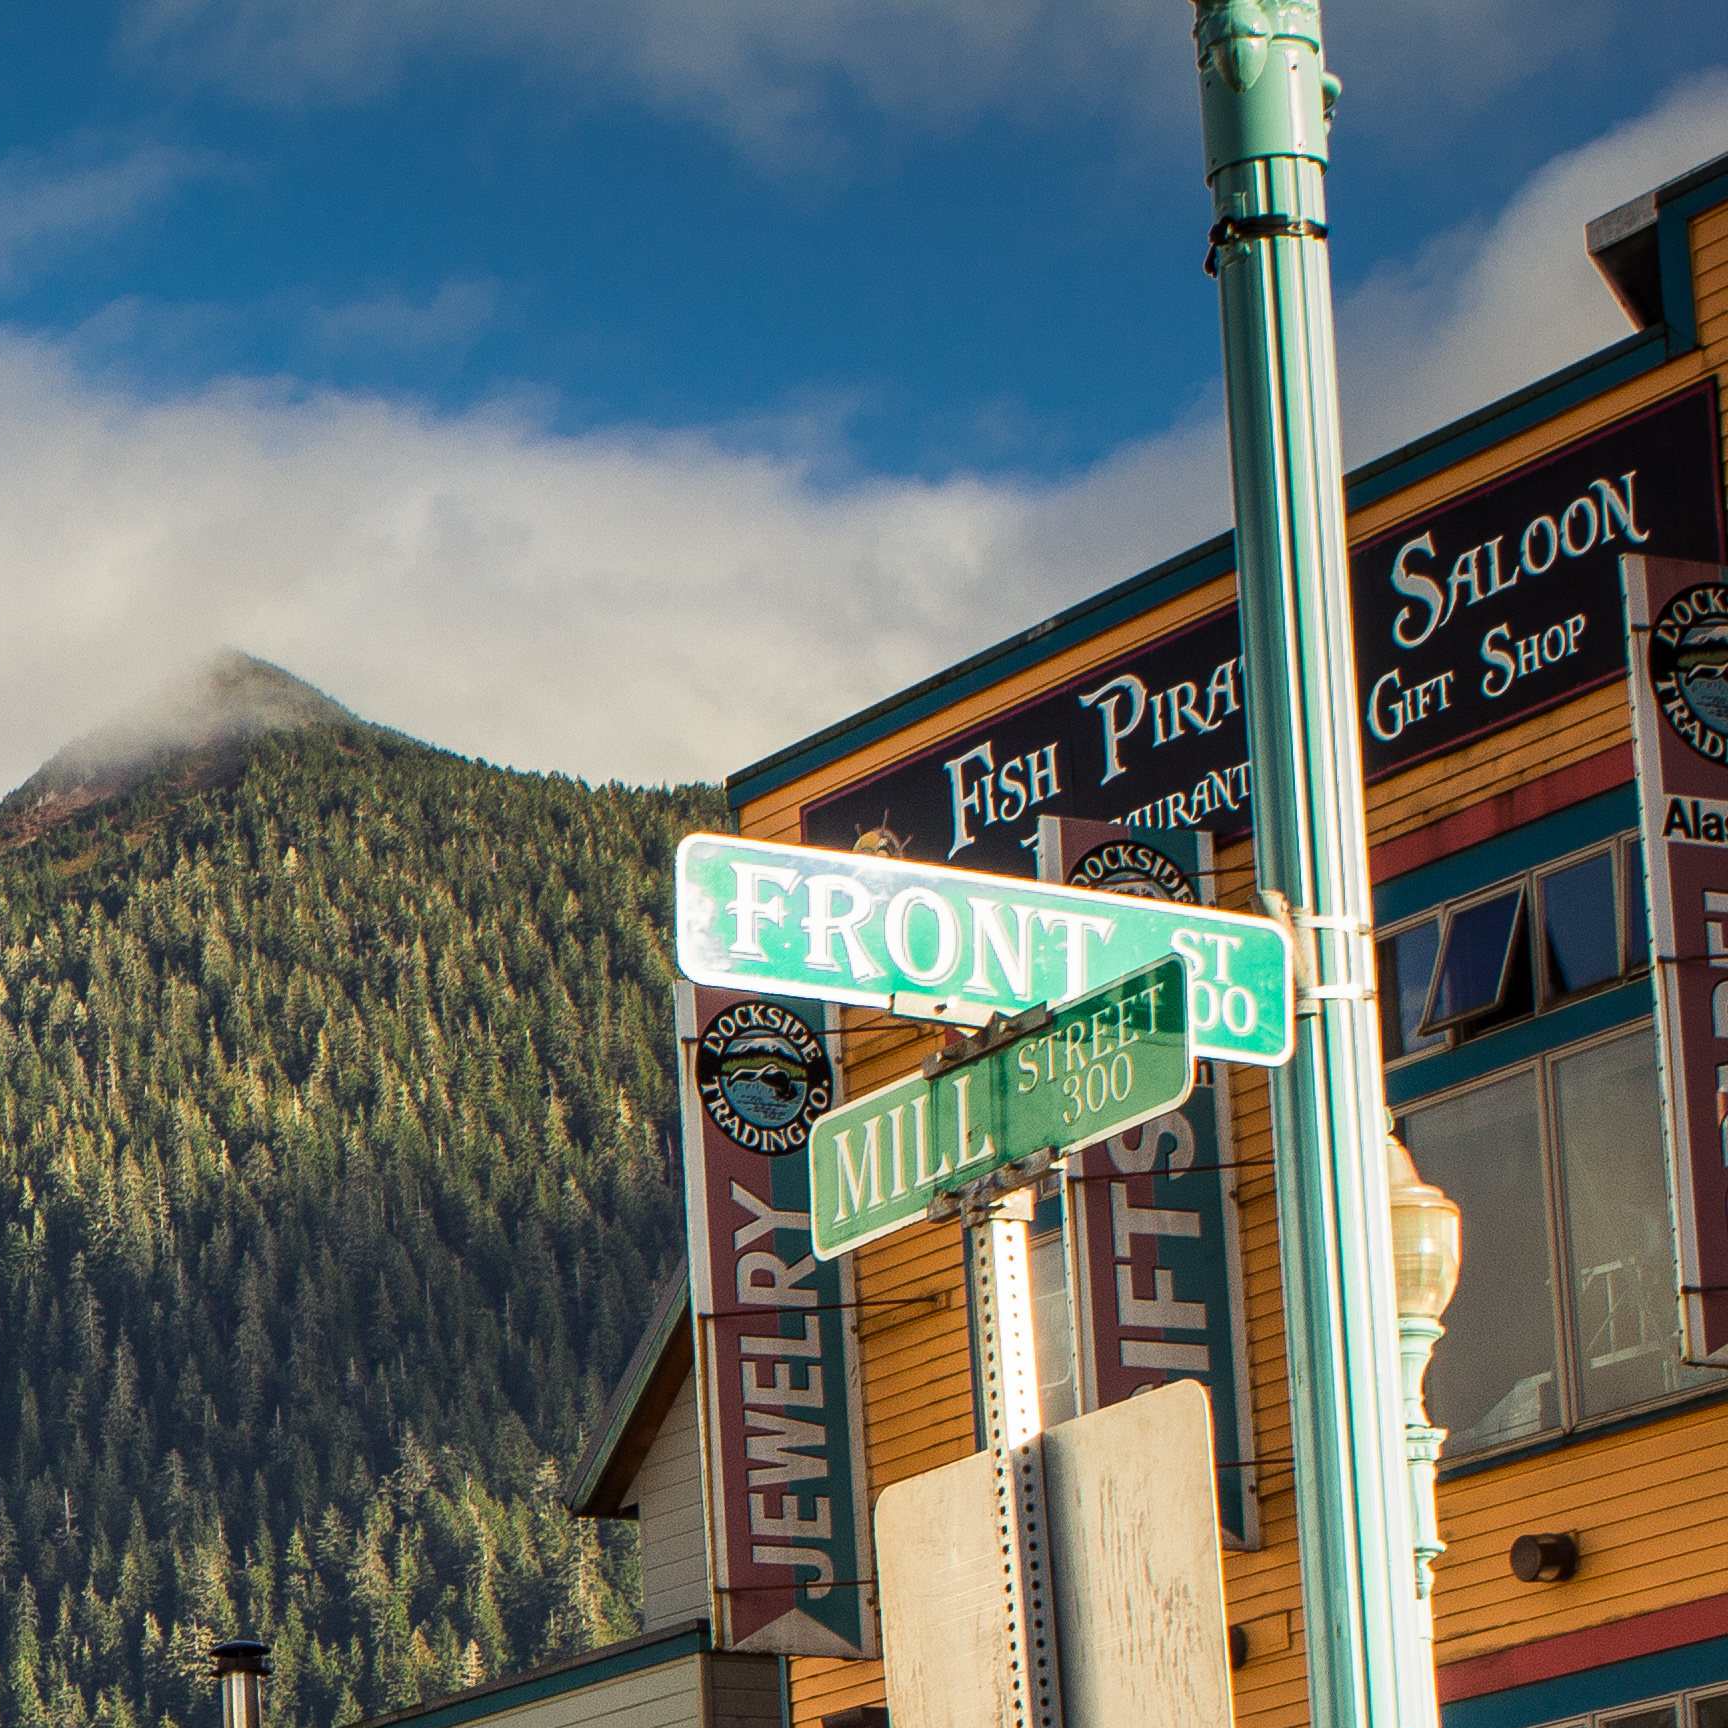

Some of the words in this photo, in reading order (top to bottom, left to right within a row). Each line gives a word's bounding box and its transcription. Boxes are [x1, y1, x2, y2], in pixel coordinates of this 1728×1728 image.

[1391, 470, 1651, 649] SALOON
[1653, 587, 1728, 649] DOCK
[1367, 668, 1455, 742] GIFT
[1480, 612, 1587, 699] SHOP
[944, 740, 1062, 861] FISH
[1078, 654, 1245, 787] PIRA
[723, 860, 1117, 1000] FRONT
[1170, 927, 1241, 983] ST
[702, 1003, 822, 1056] DOCKSIDE
[1060, 1050, 1134, 1127] 300
[701, 1075, 807, 1152] TRADING
[832, 1073, 996, 1229] MILL
[1016, 979, 1166, 1094] STREET
[1105, 1109, 1212, 1400] IFTS
[729, 1179, 835, 1600] JEWELRY
